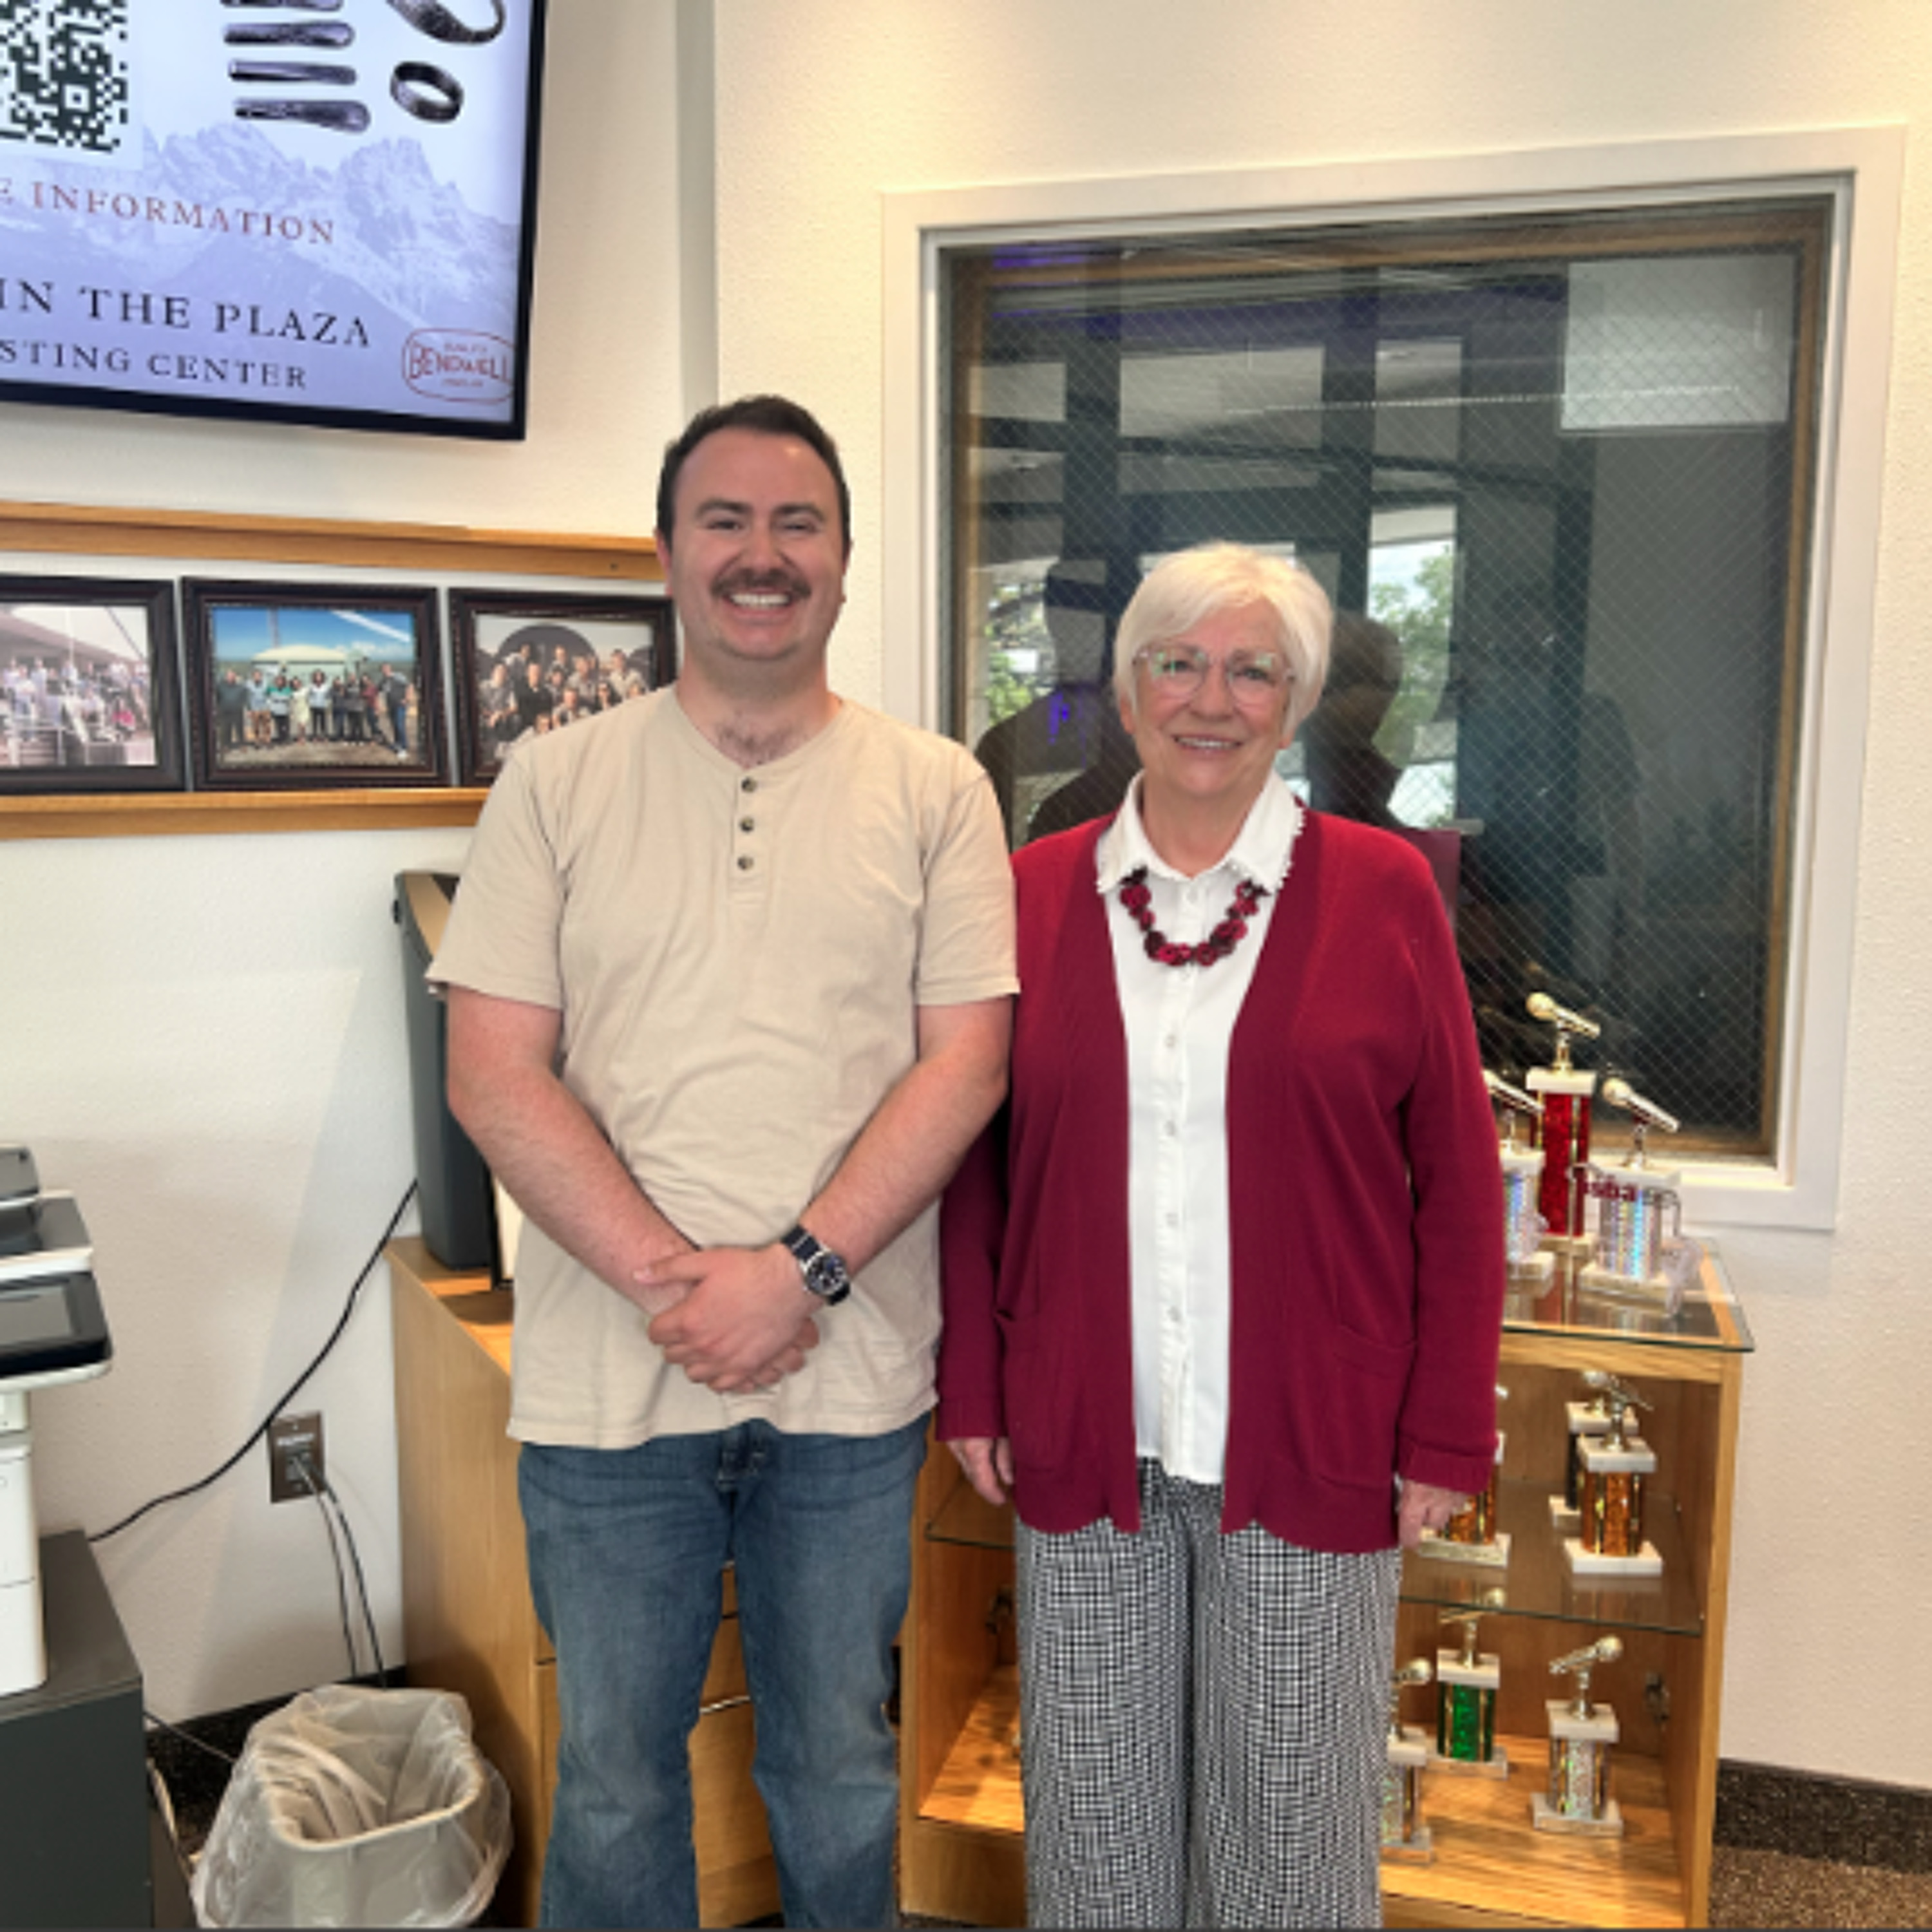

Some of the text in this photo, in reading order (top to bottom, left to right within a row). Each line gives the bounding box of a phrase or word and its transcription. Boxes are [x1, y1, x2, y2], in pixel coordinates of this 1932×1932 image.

[32, 180, 334, 245] INFORMATION
[79, 285, 189, 329] THE
[214, 301, 369, 348] PLAZA
[147, 354, 306, 389] CENTER
